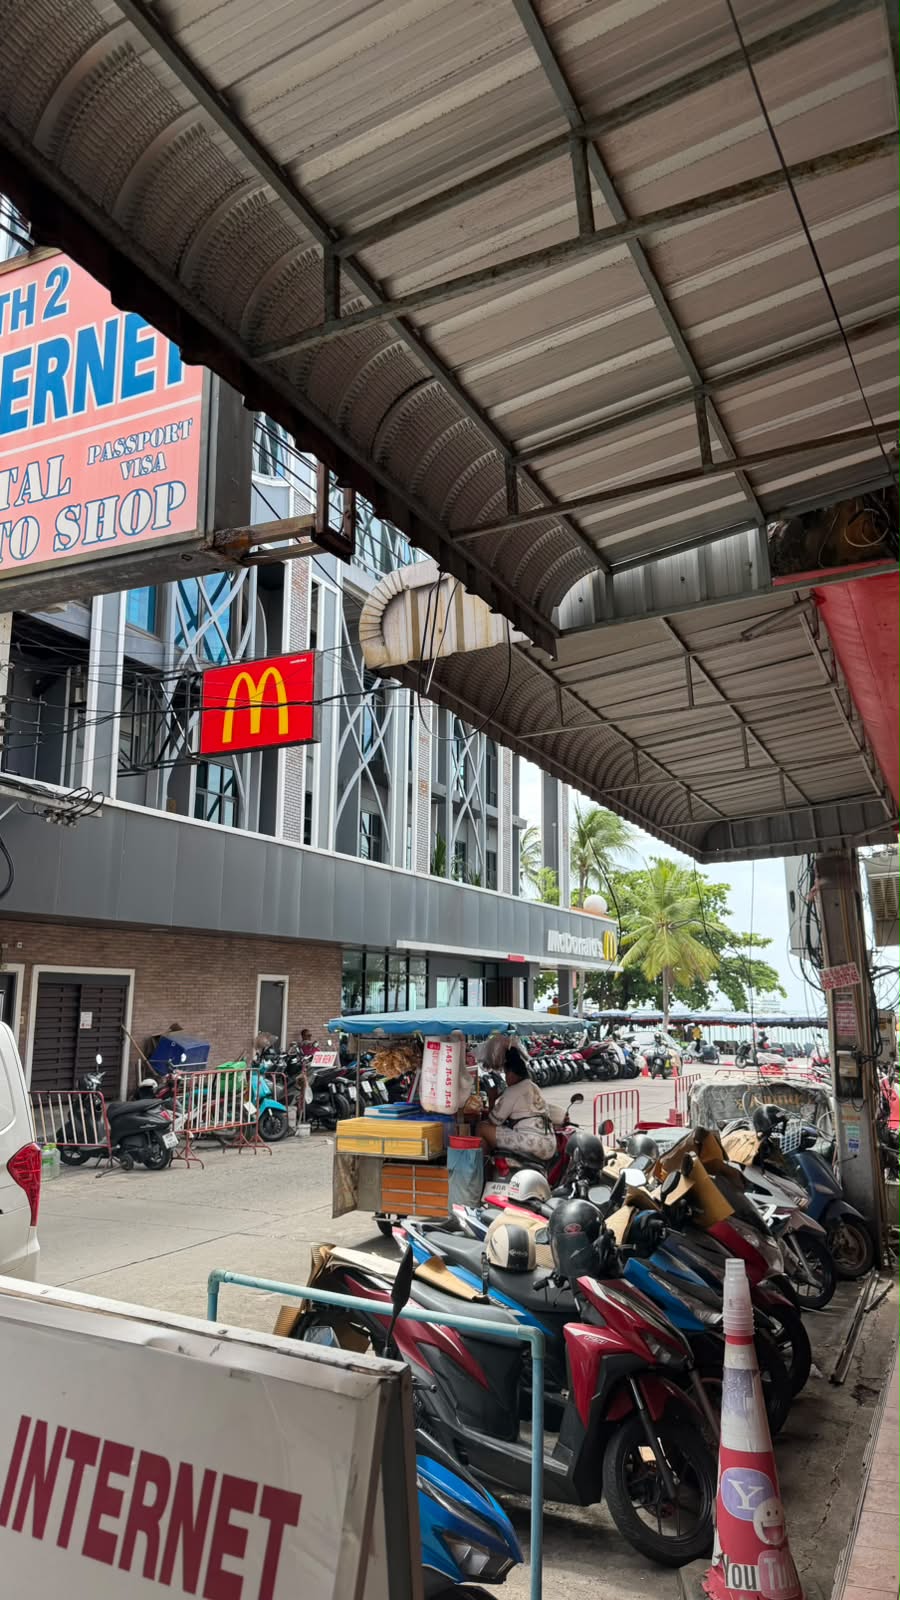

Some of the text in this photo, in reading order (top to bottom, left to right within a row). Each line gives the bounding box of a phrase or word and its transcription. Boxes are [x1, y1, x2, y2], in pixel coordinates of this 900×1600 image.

[43, 265, 70, 320] 2
[87, 418, 193, 466] PASSPORT
[120, 451, 167, 480] VISA
[53, 480, 187, 552] SHOP
[0, 1414, 302, 1600] INTERNET
